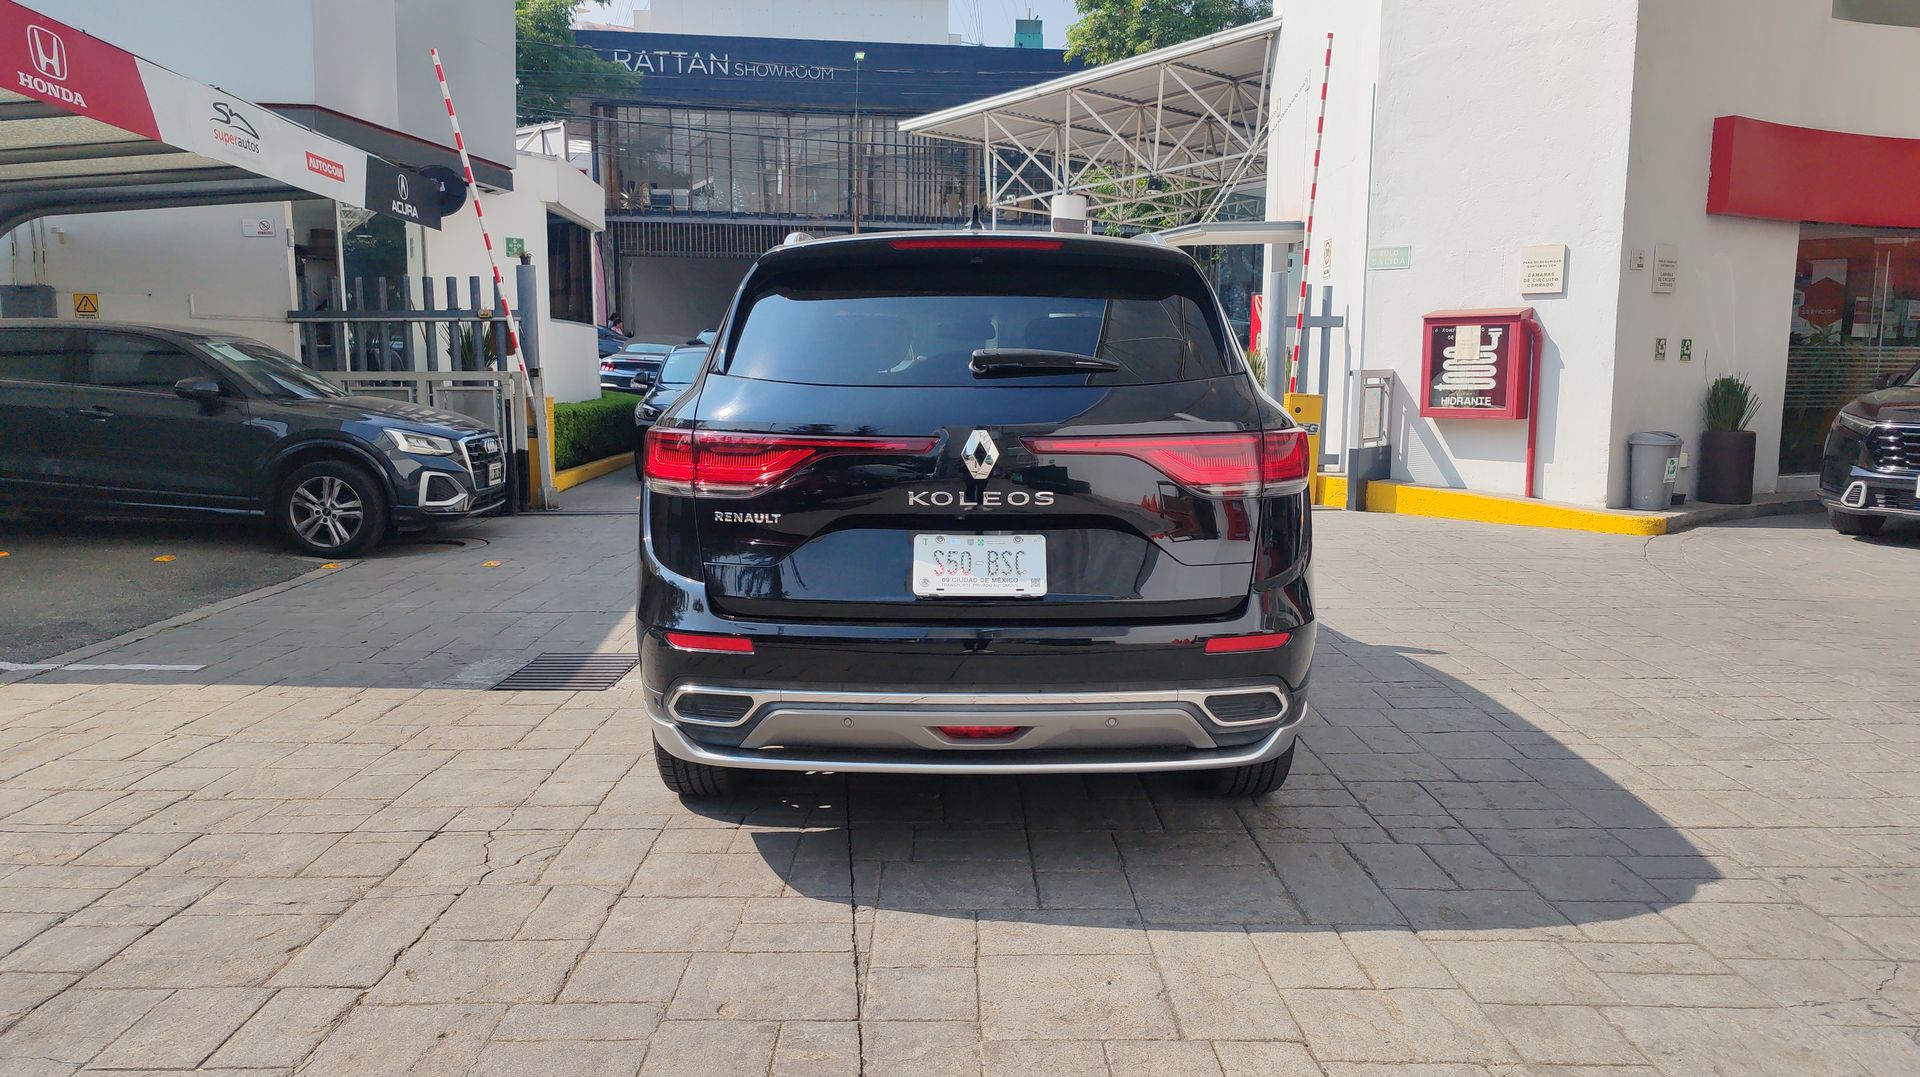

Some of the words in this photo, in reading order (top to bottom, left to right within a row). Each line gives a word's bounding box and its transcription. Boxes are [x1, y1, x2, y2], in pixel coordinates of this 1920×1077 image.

[614, 49, 729, 75] RATTAN
[734, 62, 834, 80] SHOWROOM
[17, 71, 88, 108] HONDA
[213, 128, 260, 154] superautos
[308, 156, 344, 179] AUTOCOM
[391, 199, 419, 219] ACURA
[1440, 396, 1492, 406] HIDRANTE
[908, 491, 1054, 506] KOLEOS
[714, 511, 782, 524] RENAULT
